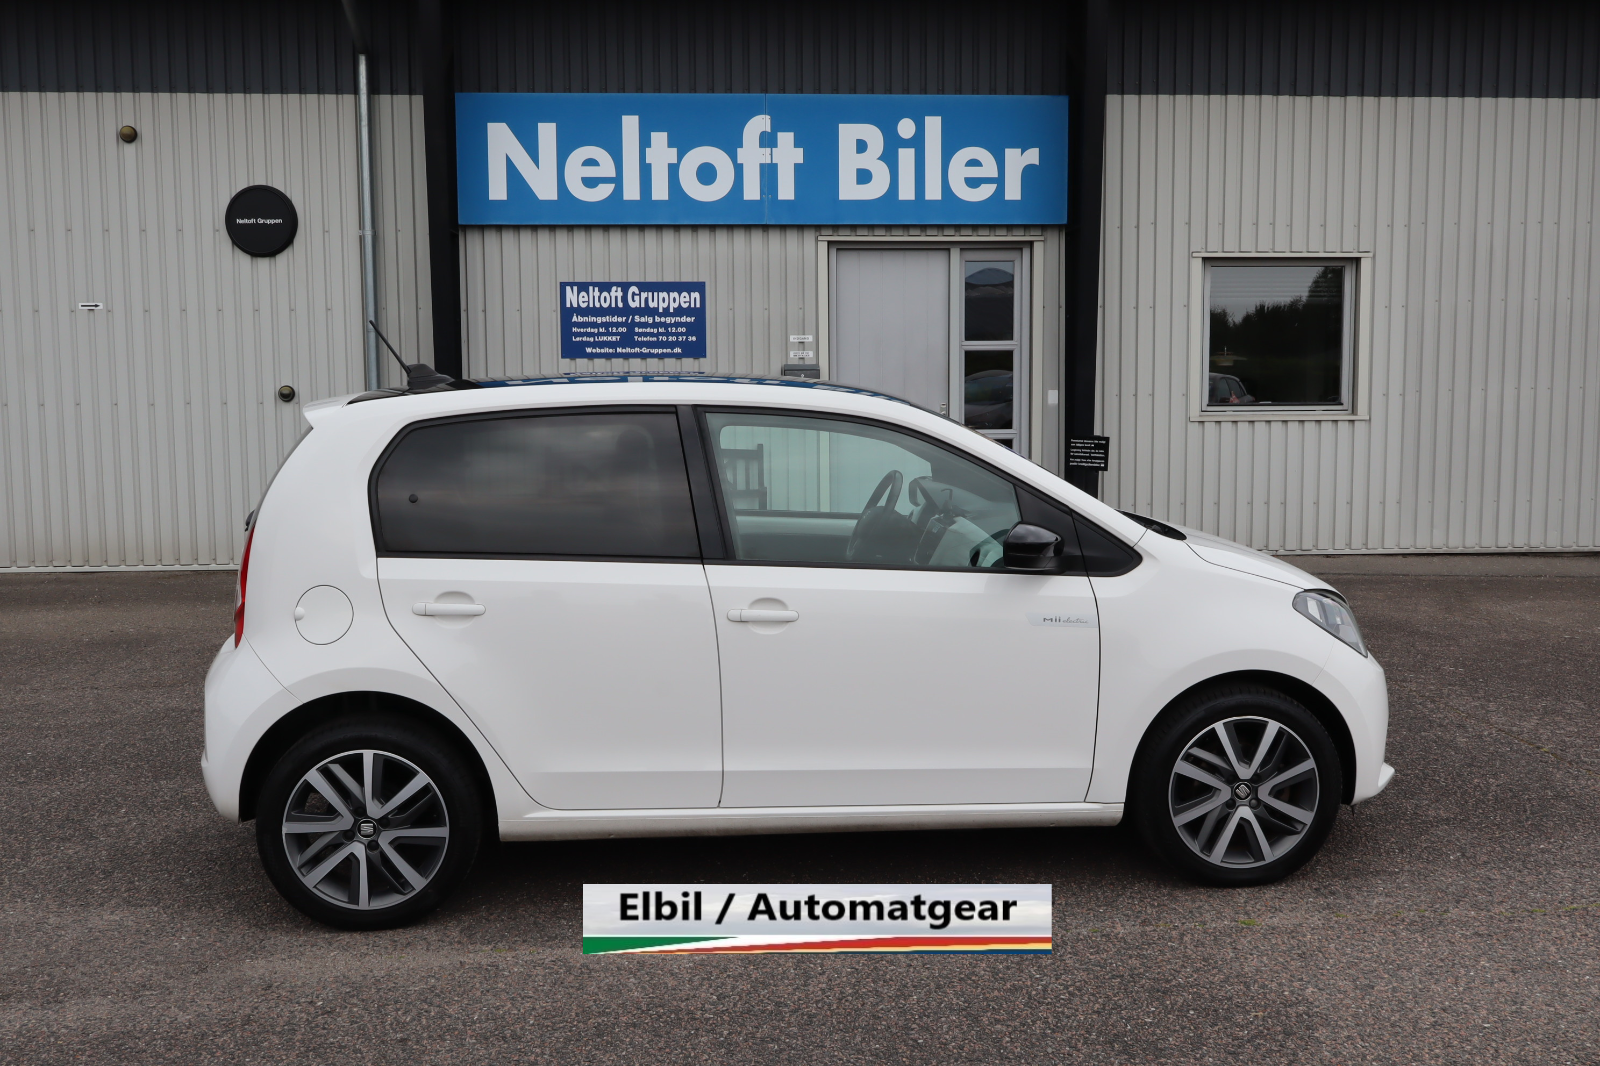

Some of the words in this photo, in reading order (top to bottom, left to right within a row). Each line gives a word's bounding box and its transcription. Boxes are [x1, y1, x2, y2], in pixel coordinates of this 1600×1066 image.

[487, 114, 803, 202] Neltoft
[838, 115, 1039, 202] Biler
[566, 286, 623, 308] Neltoft
[627, 286, 700, 312] Gruppen
[571, 313, 626, 323] Åbningstider
[628, 315, 632, 323] /
[634, 315, 653, 323] Salg
[655, 315, 695, 323] begynder
